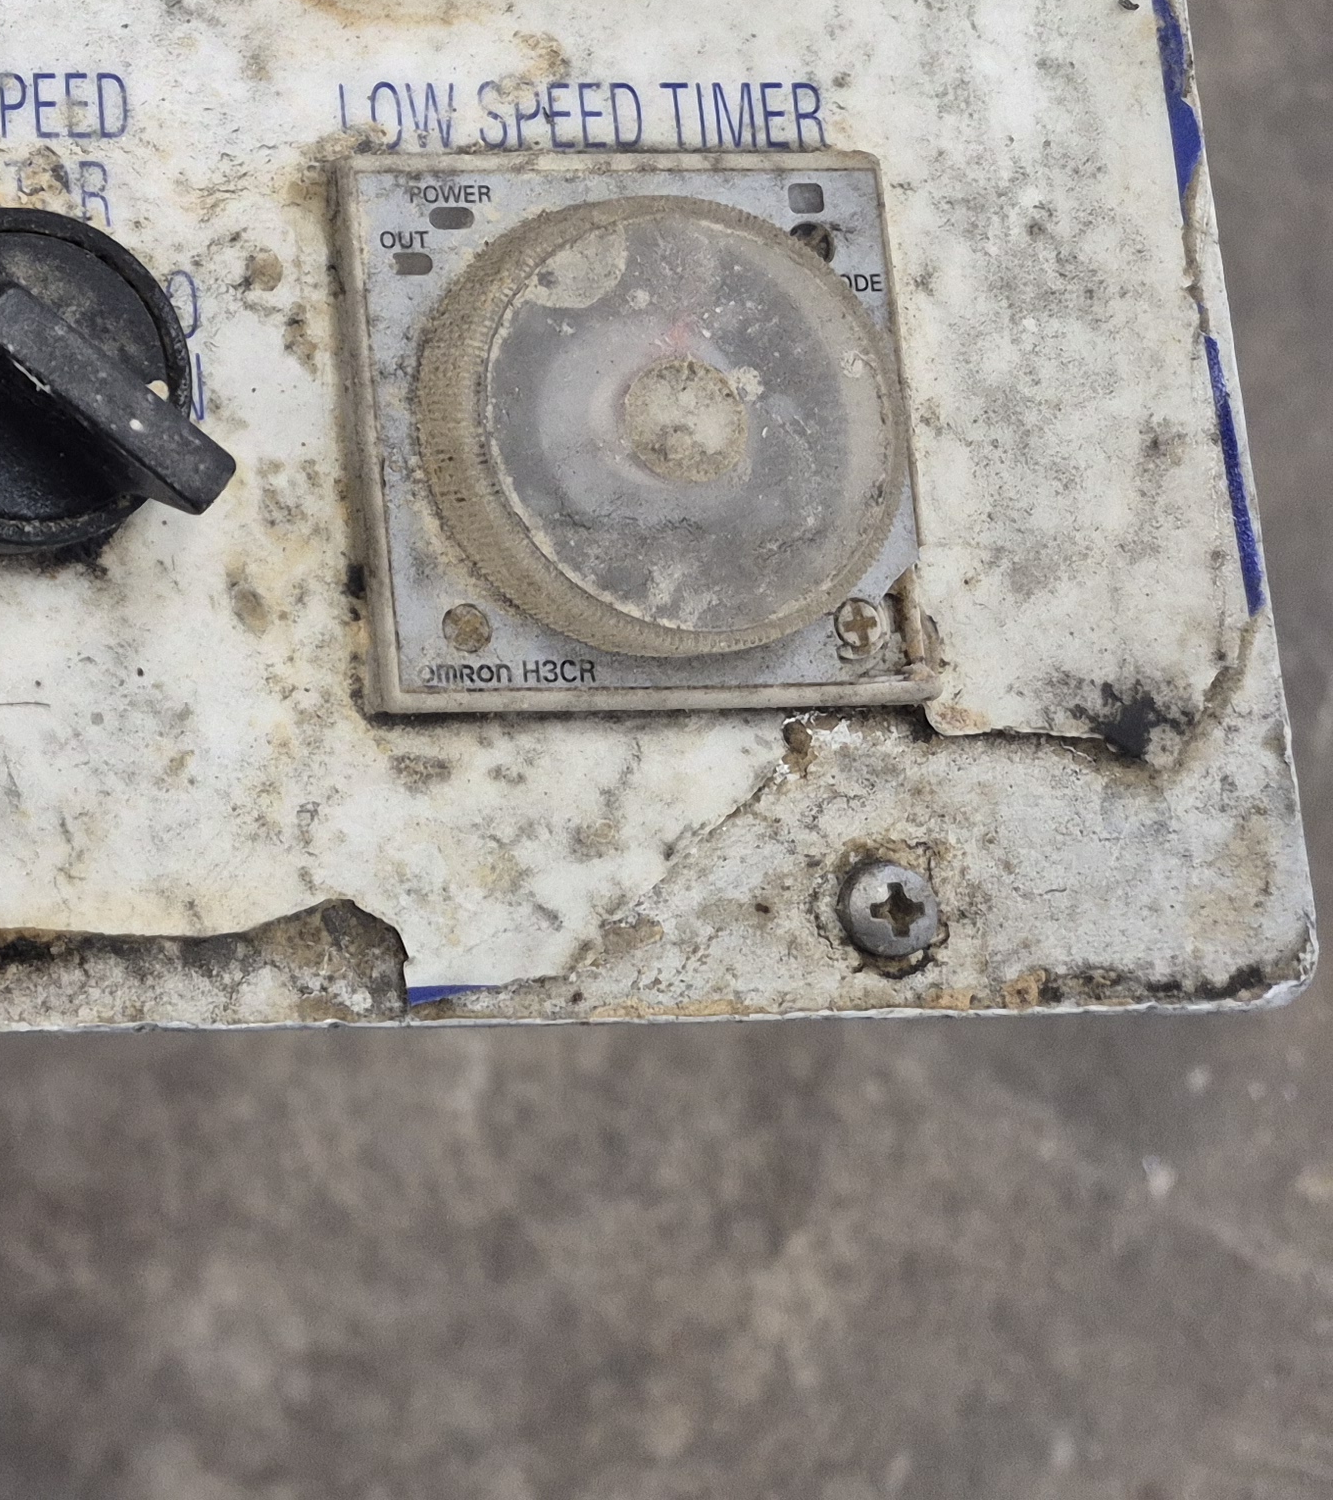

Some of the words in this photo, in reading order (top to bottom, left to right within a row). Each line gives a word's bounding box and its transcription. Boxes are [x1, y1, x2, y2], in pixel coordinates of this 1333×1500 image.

[338, 81, 455, 149] LOW
[477, 80, 643, 149] SPEED
[659, 81, 830, 148] TIMER
[409, 184, 492, 204] POWER
[379, 230, 429, 249] OUT
[522, 659, 597, 684] H3CR
